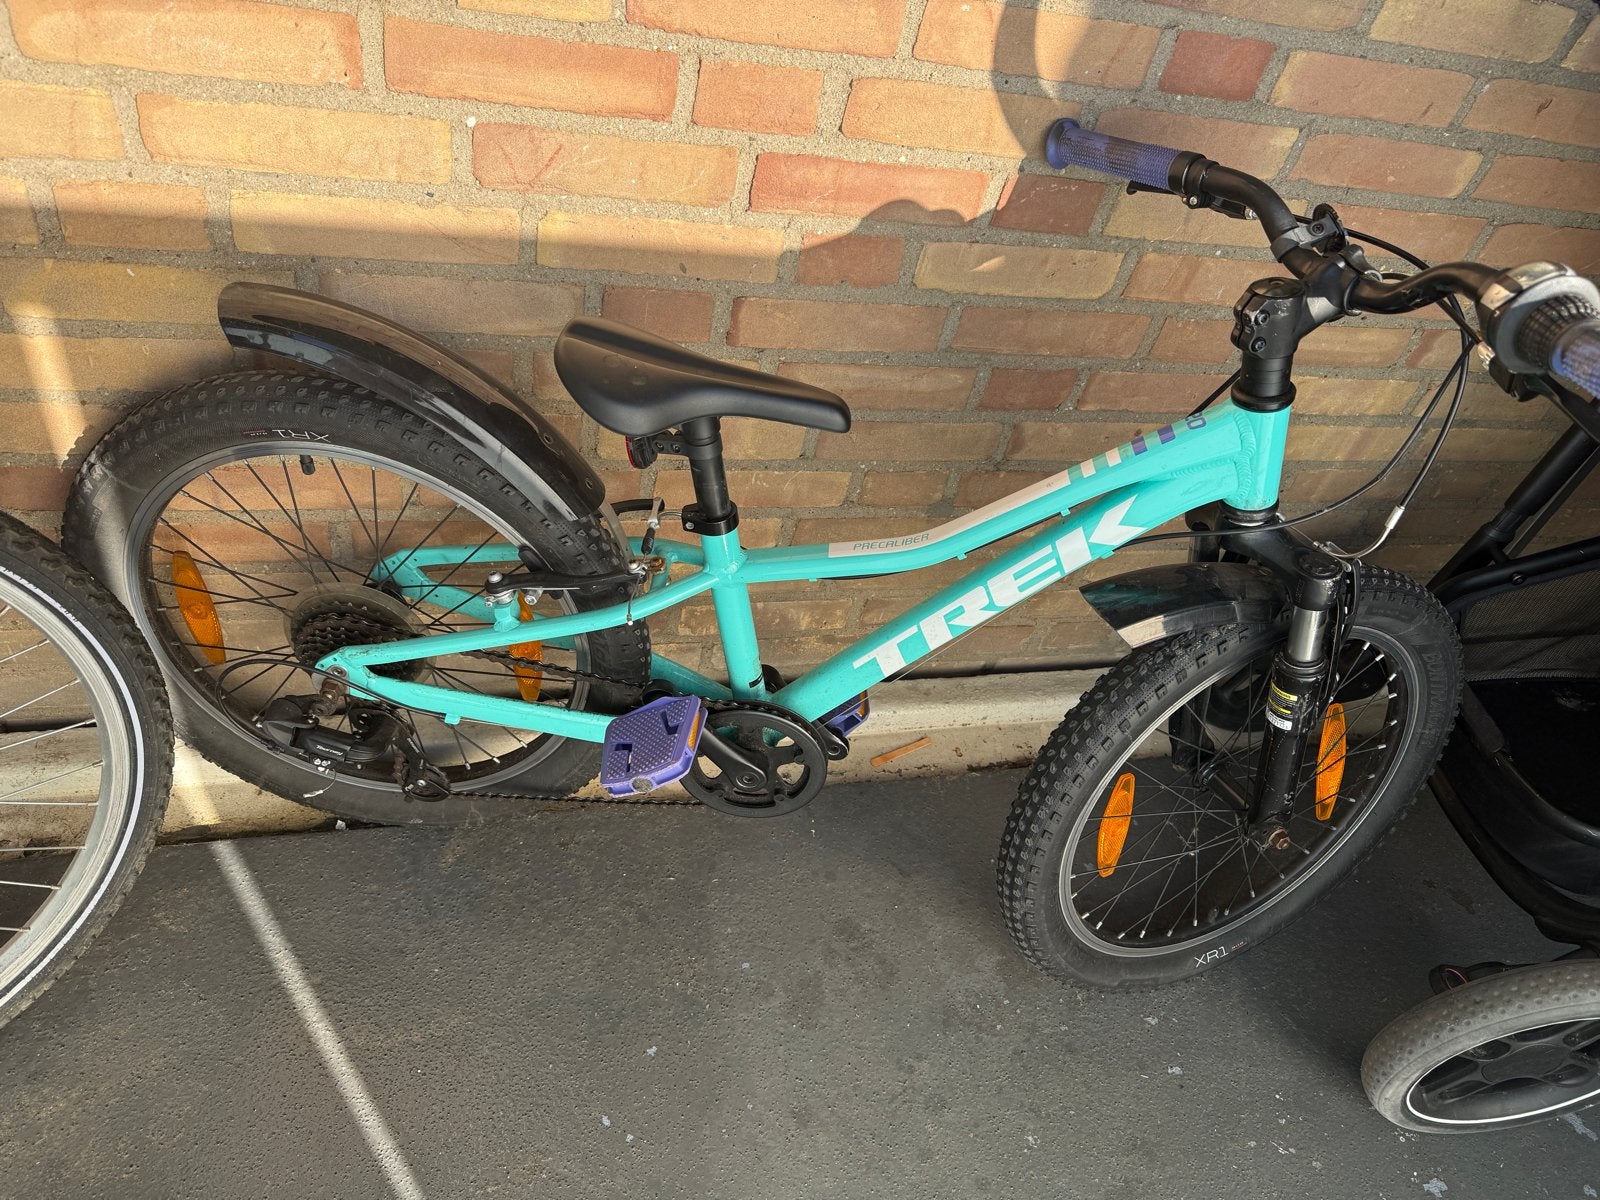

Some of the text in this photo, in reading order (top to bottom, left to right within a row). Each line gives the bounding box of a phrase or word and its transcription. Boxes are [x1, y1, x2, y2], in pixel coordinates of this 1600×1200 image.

[272, 429, 331, 443] XR1
[853, 533, 930, 551] PRECALIBER
[852, 494, 1148, 678] TREK
[1193, 946, 1229, 968] XR1
